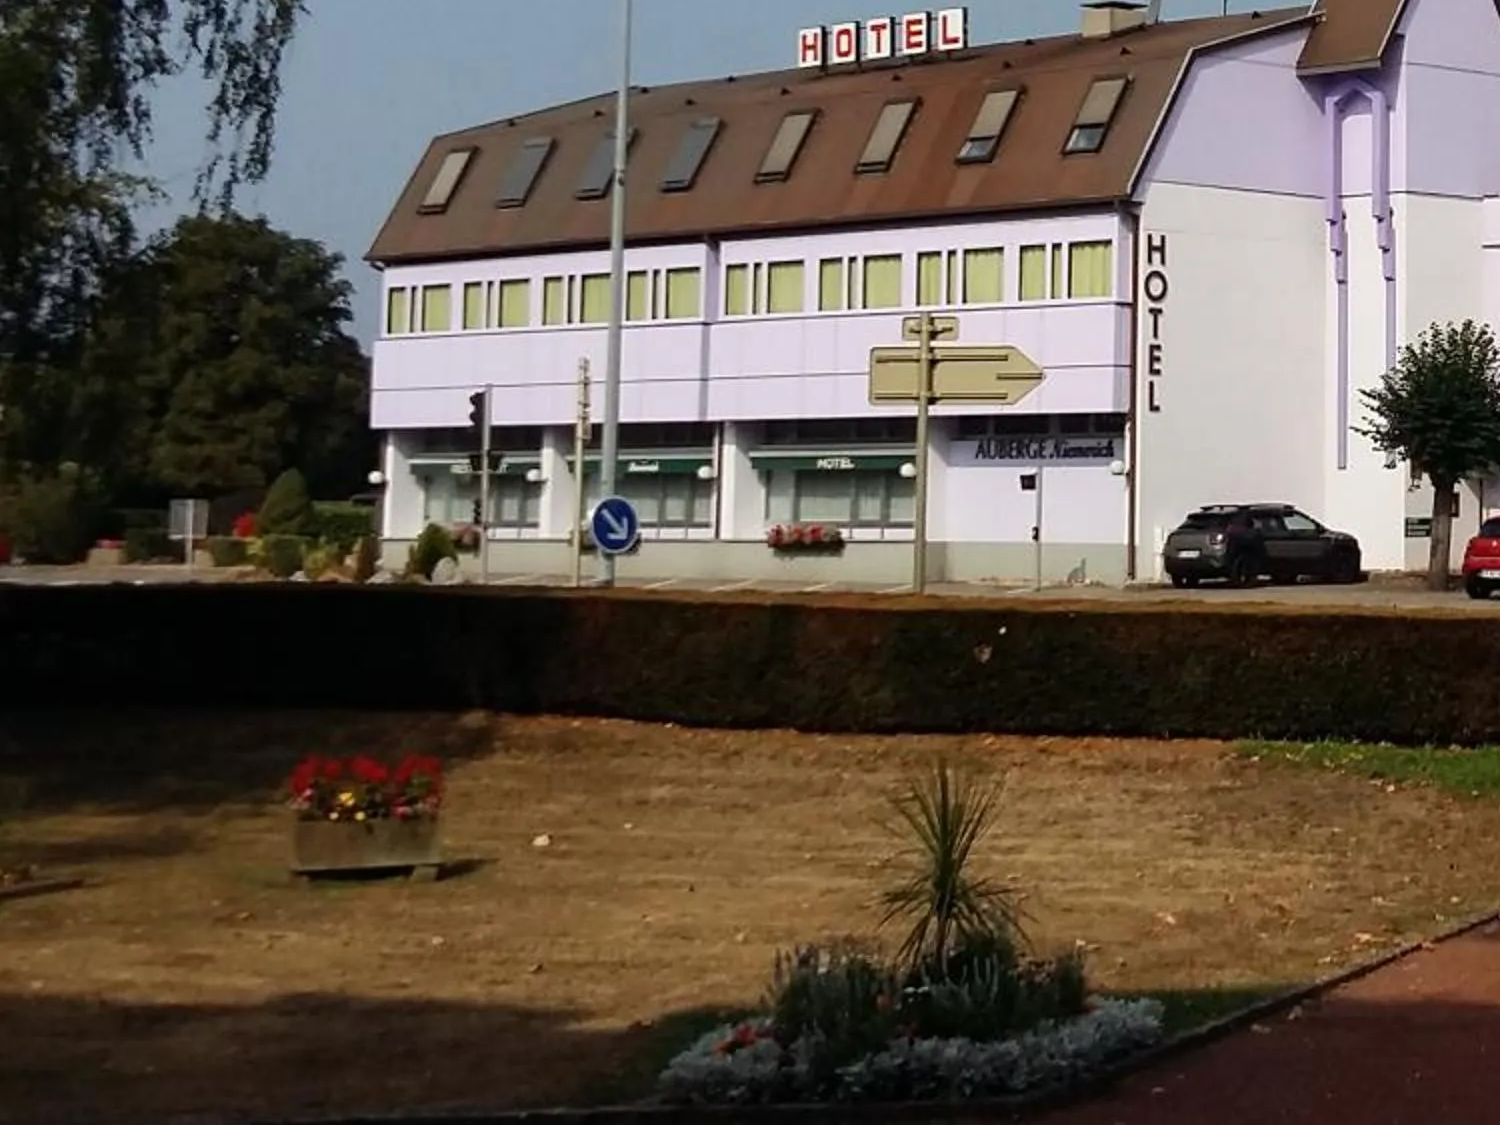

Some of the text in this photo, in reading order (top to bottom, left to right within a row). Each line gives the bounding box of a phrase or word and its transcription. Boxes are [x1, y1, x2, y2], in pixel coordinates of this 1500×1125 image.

[800, 15, 961, 63] HOTEL
[1144, 233, 1168, 413] HOTEL
[974, 437, 1046, 460] AUBERGE
